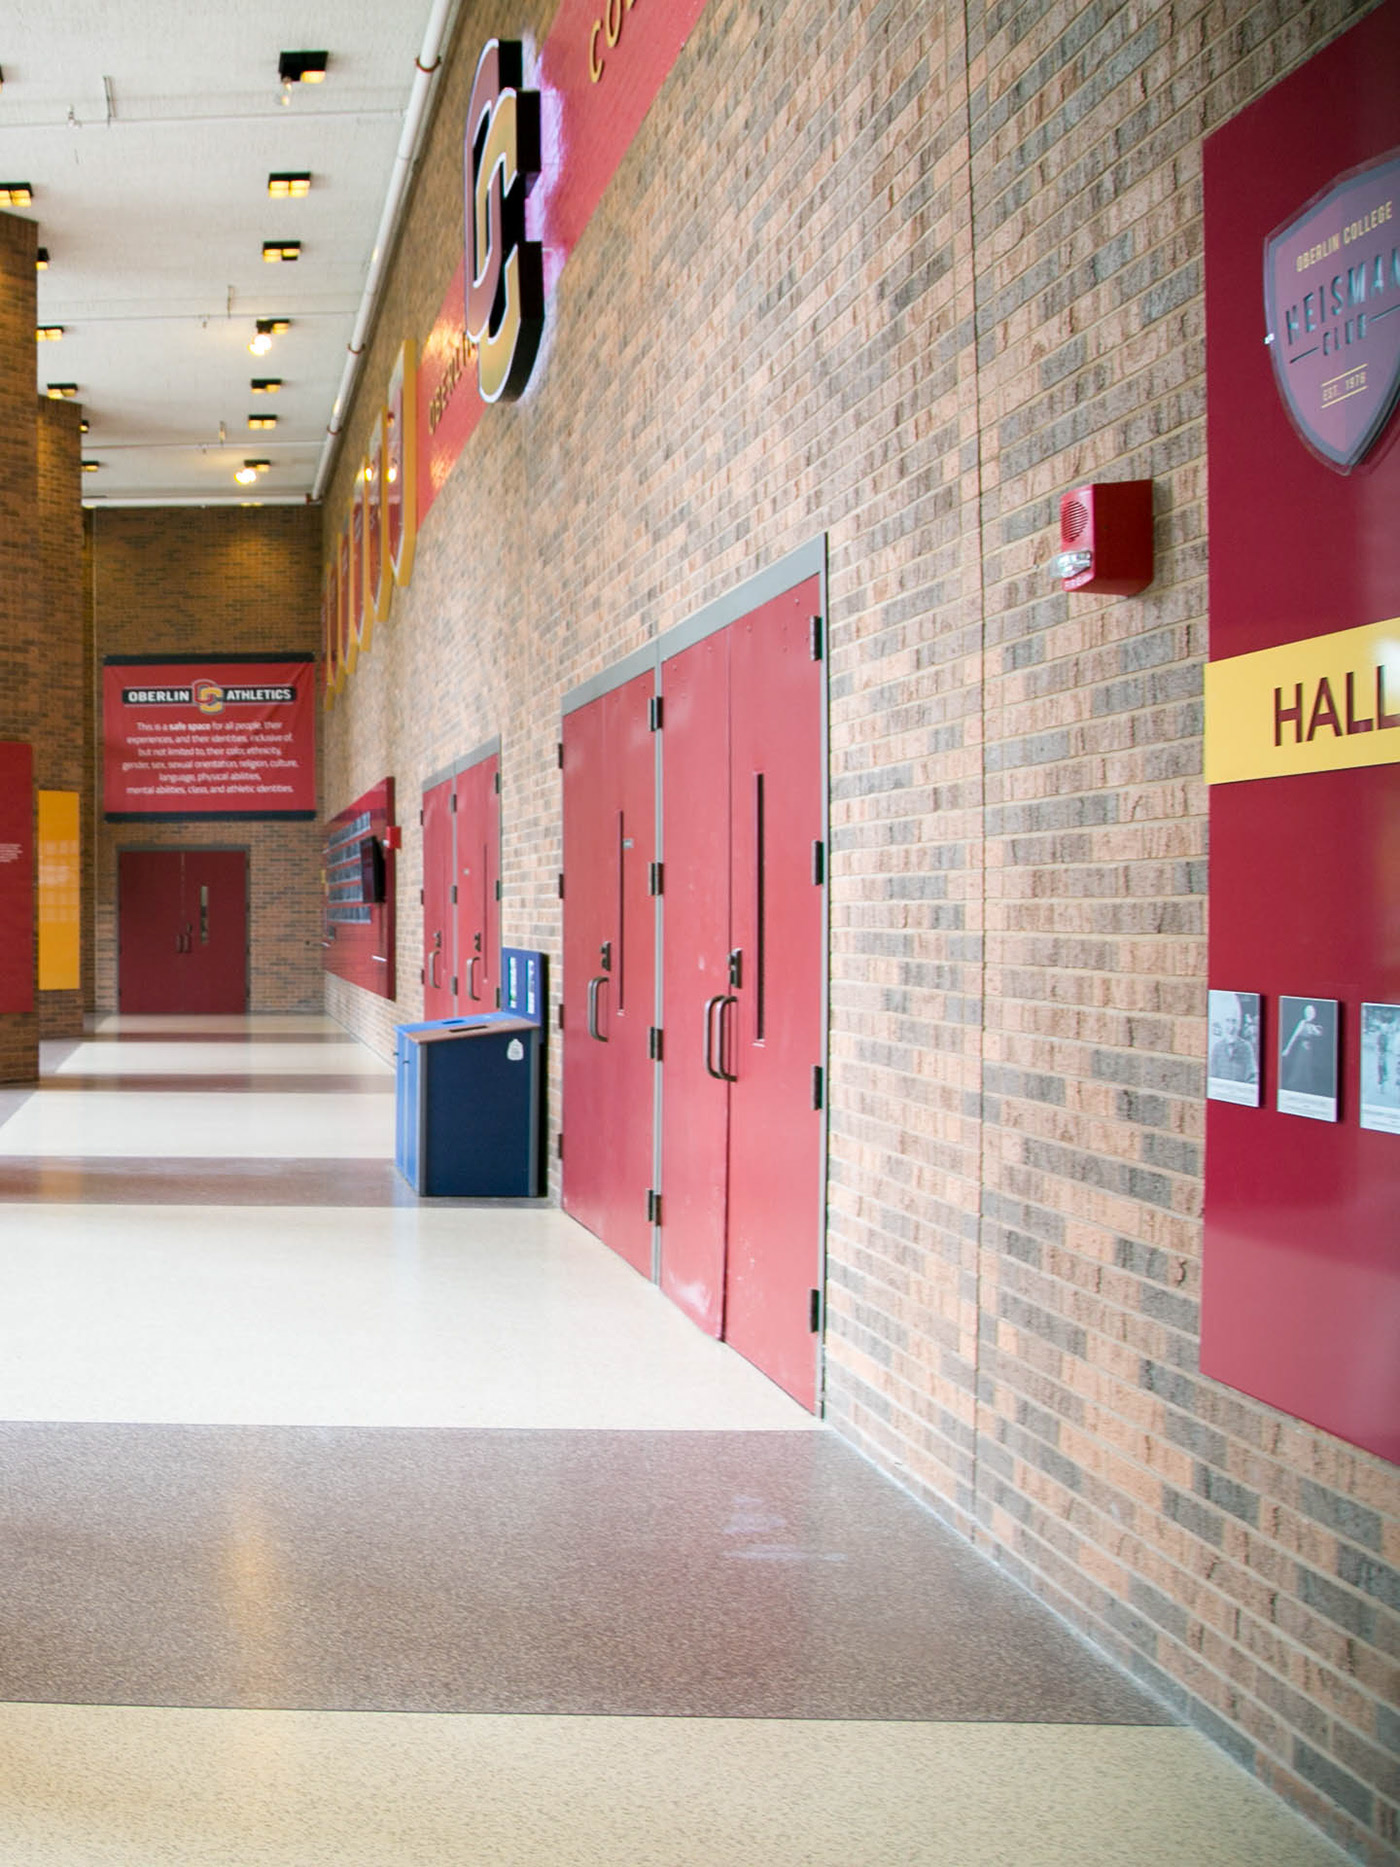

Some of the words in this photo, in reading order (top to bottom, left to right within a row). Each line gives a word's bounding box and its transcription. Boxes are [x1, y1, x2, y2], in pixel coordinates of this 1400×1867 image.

[1296, 232, 1340, 272] OBERLIN
[1343, 200, 1393, 245] COLLEGE
[1322, 312, 1367, 356] CLUB
[128, 691, 189, 702] OBERLIN
[226, 689, 292, 701] ATHLETICS
[1274, 663, 1400, 747] HALL
[169, 722, 186, 730] safe
[188, 723, 211, 731] space
[212, 722, 222, 730] for
[225, 722, 234, 730] all
[167, 748, 194, 756] limited
